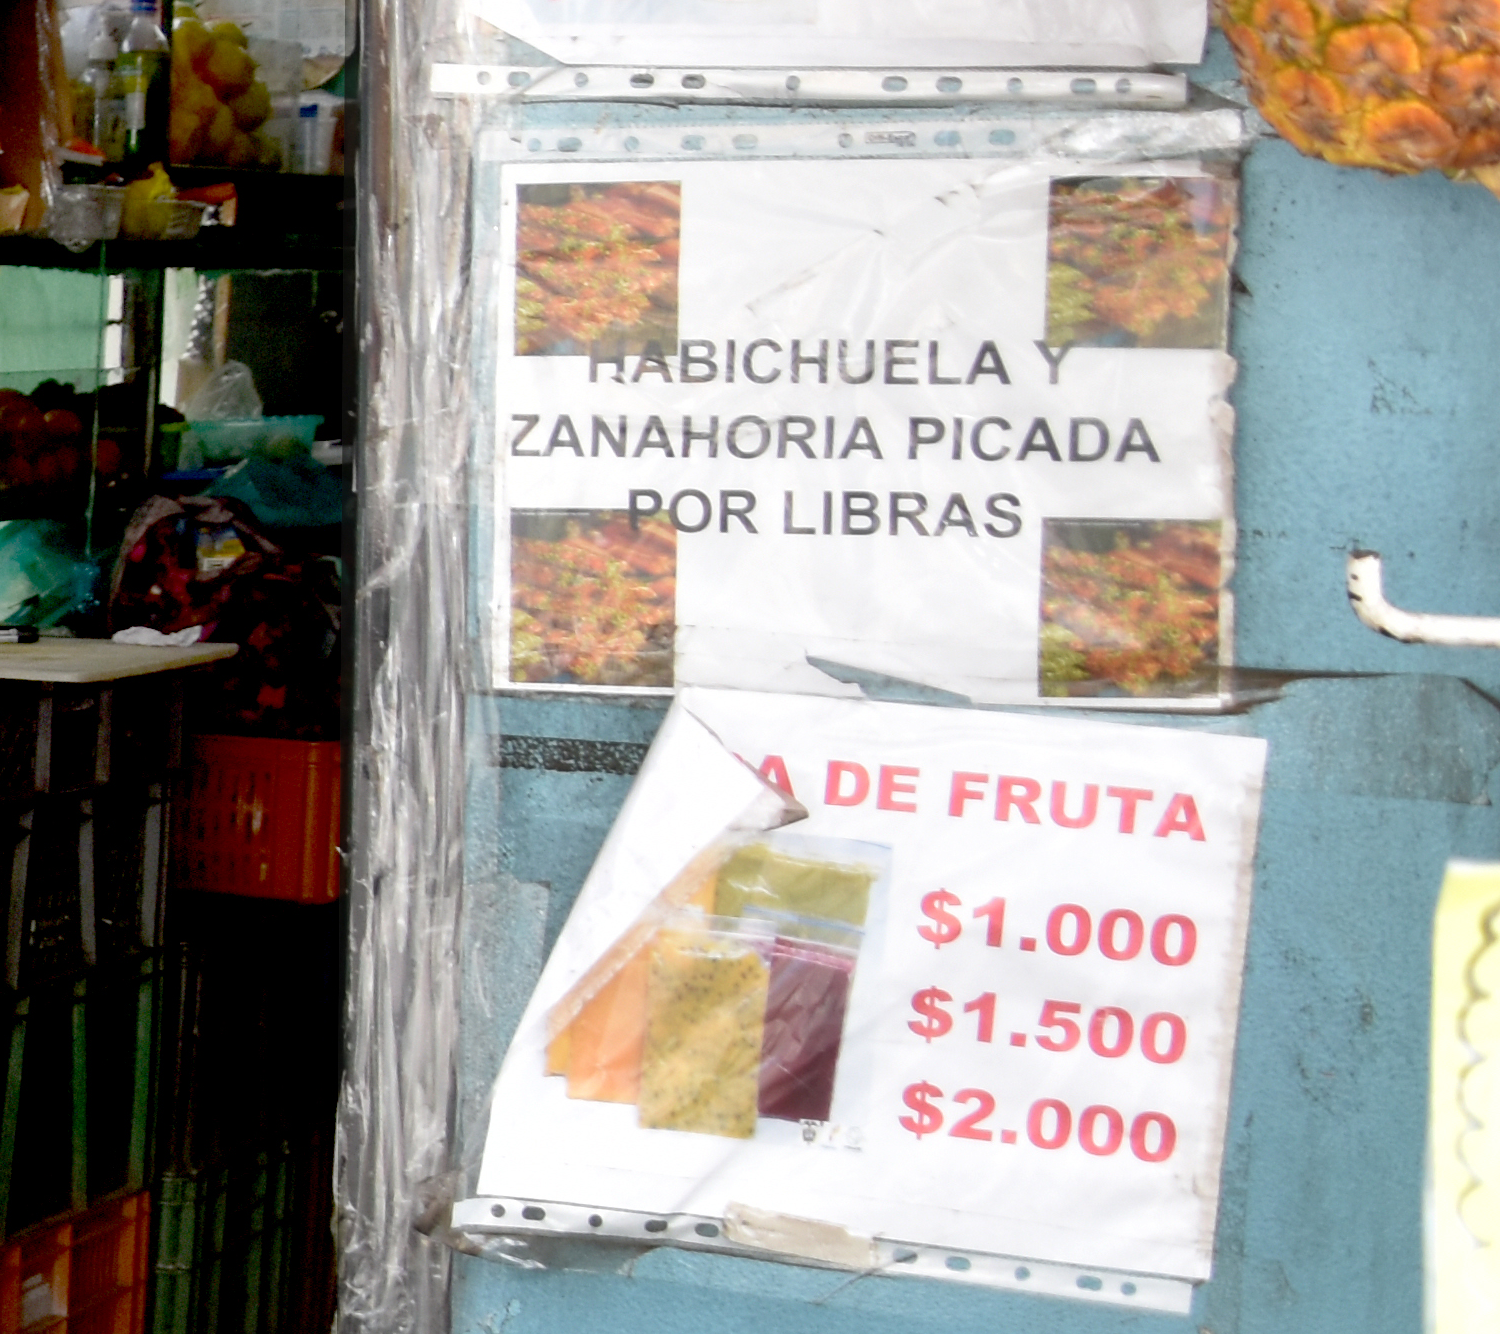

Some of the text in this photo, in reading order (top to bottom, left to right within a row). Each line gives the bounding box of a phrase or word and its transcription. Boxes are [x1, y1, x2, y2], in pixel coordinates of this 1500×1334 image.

[587, 337, 1074, 387] HABICHUELA Y
[510, 414, 1161, 466] ZANAHORIA PICADA
[628, 487, 1024, 540] POR LIBRAS
[823, 759, 921, 814] DE
[947, 771, 1206, 842] FRUTA
[917, 887, 1198, 968] $1.000
[906, 985, 1187, 1065] $1.500
[898, 1080, 1178, 1163] $2.000
